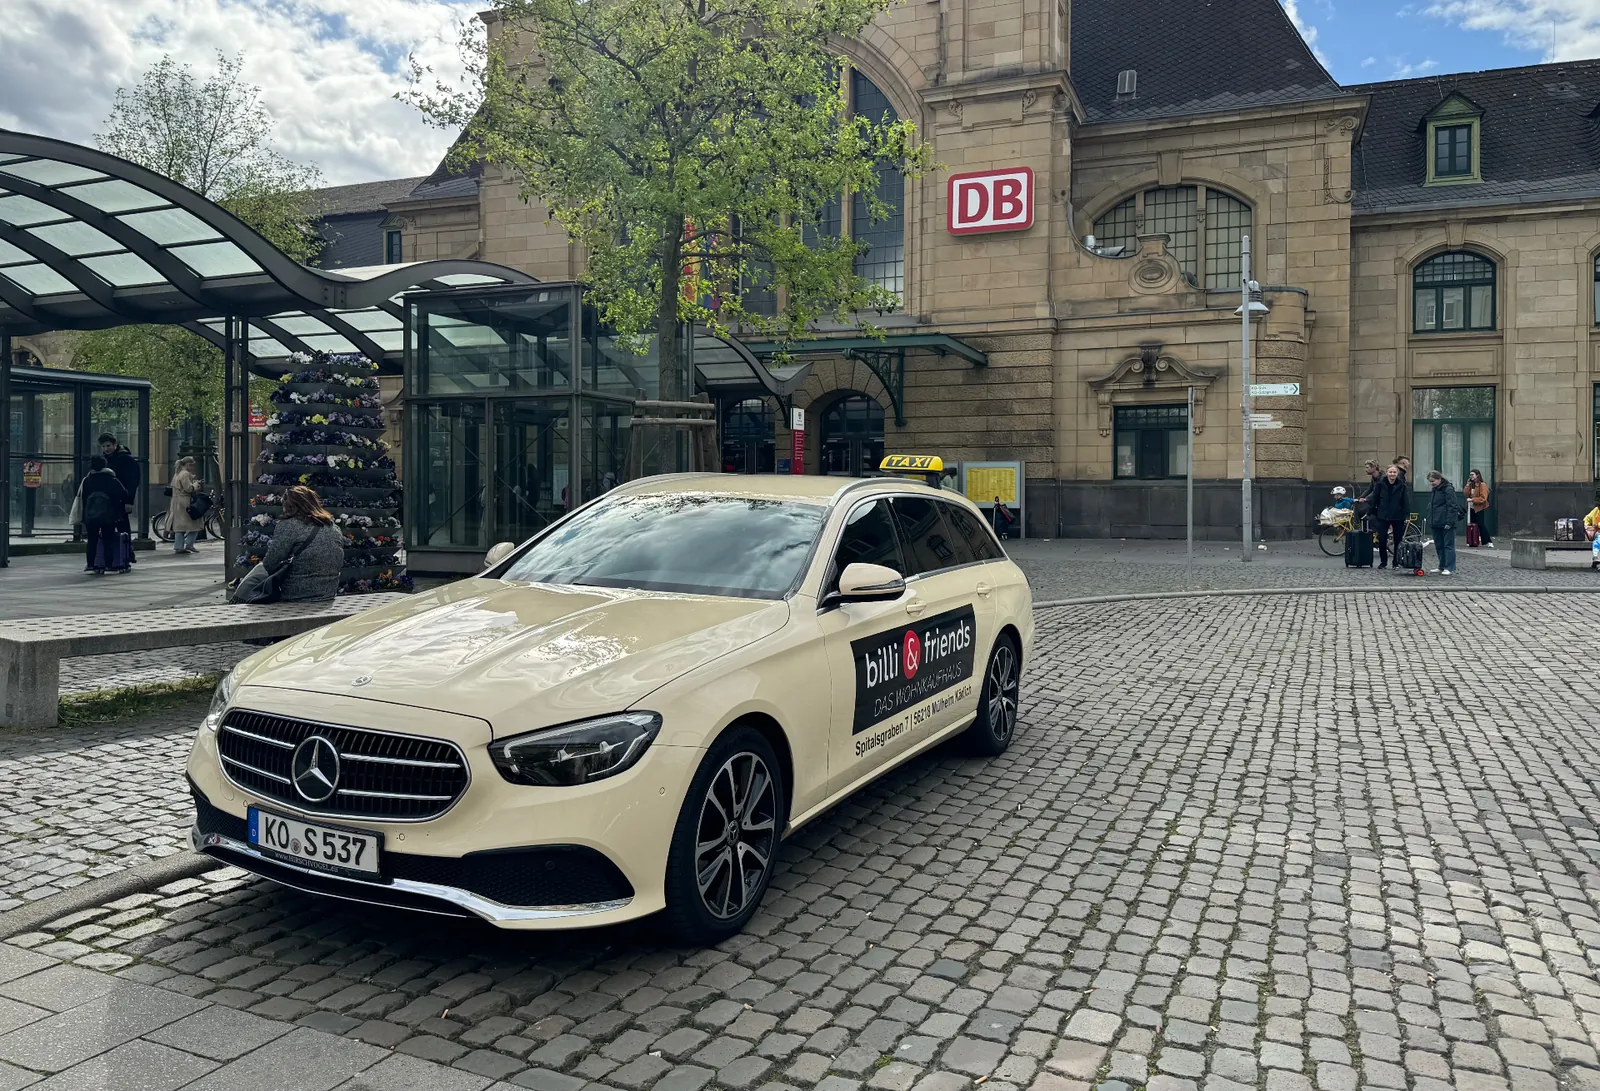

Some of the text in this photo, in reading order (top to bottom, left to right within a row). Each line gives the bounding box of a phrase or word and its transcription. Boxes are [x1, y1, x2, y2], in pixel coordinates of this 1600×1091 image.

[958, 178, 1023, 224] DB
[890, 456, 931, 467] TAXI
[865, 619, 970, 689] billi & friends
[874, 661, 962, 717] DAS WOHNKAUFHAUS
[855, 721, 904, 758] Spitalsgraben
[904, 715, 909, 730] 7
[265, 816, 367, 866] KO S 537
